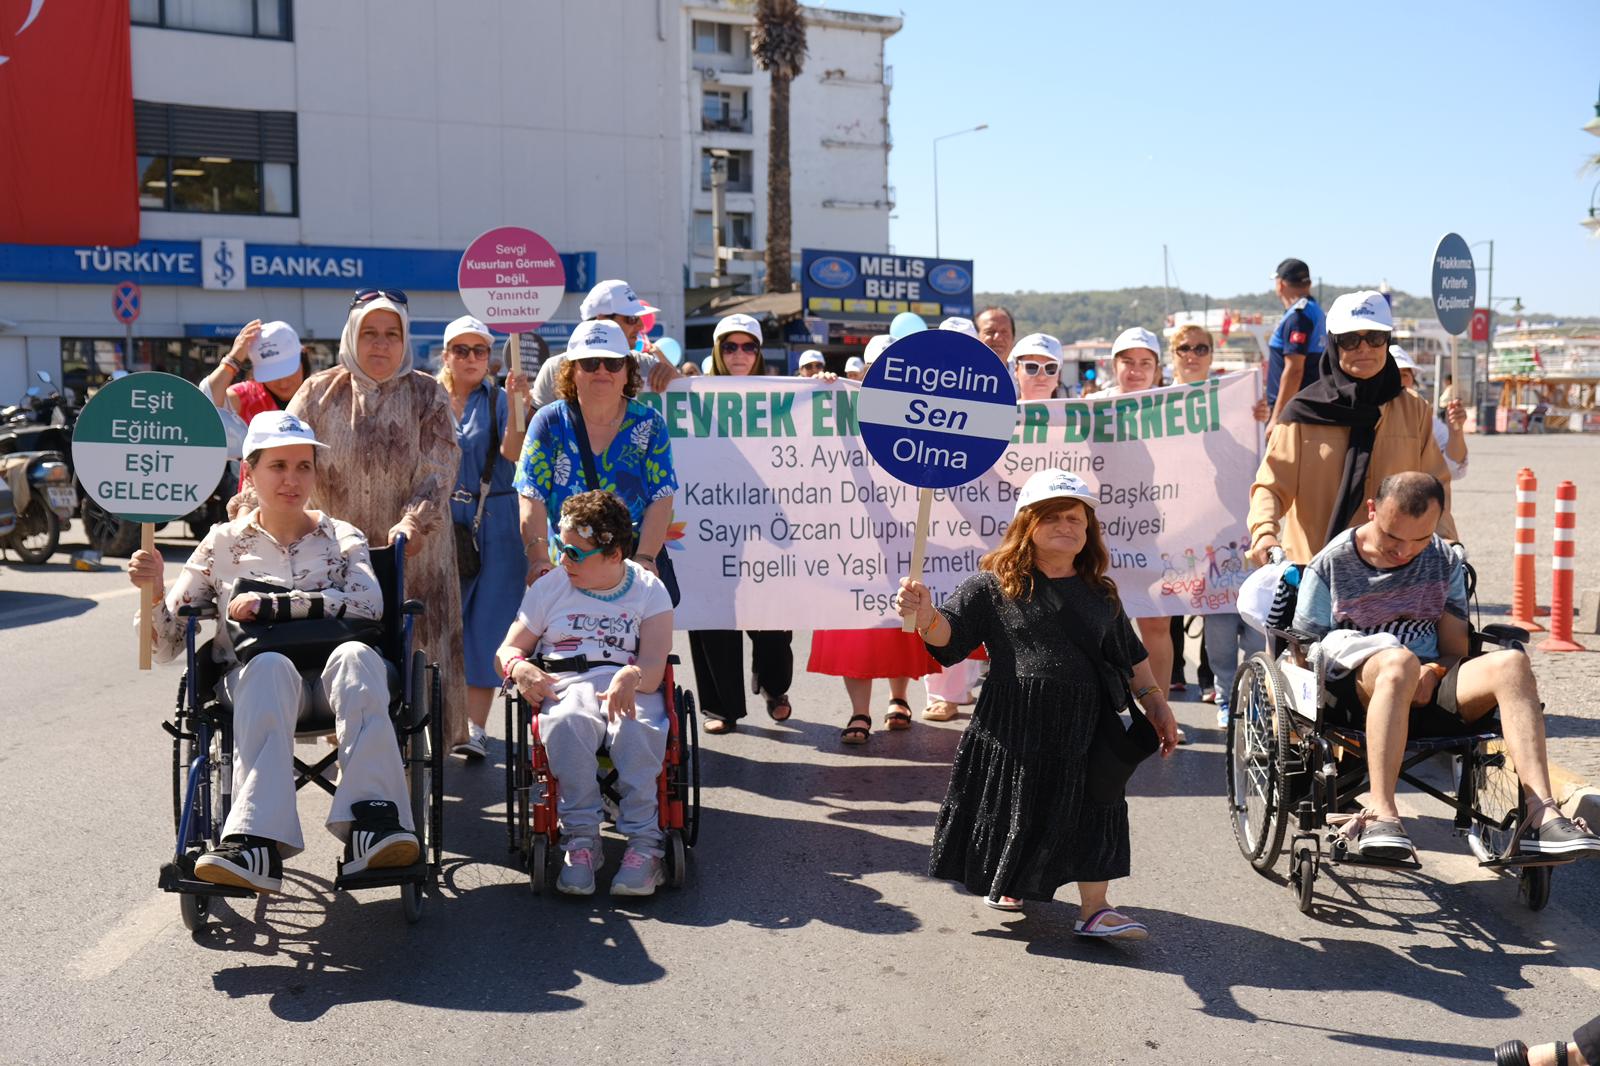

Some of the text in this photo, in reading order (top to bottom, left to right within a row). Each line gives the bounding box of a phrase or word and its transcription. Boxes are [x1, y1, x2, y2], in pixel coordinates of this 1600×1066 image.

[74, 245, 195, 274] TÜRKİYE
[250, 255, 363, 278] BANKASI
[496, 244, 526, 256] Sevgi
[466, 258, 556, 269] Kusurları Görmek
[495, 273, 529, 285] Değil,
[1441, 276, 1468, 289] Kriterle
[487, 290, 538, 301] Yanında
[486, 306, 540, 317] Olmaktır
[884, 356, 998, 394] Engelim
[131, 389, 174, 413] Eşit
[1064, 379, 1220, 444] DERNEĞİ
[904, 399, 968, 430] Sen
[112, 419, 189, 443] Eğitim,
[126, 450, 174, 476] EŞİT
[771, 445, 804, 468] 33.
[1004, 451, 1105, 474] Şenliğine
[892, 437, 968, 470] Olma
[98, 480, 198, 502] GELECEK
[685, 481, 832, 506] Katkılarından
[841, 480, 906, 508] Dolayı
[916, 480, 990, 502] evrek
[1100, 482, 1179, 509] Başkanı
[699, 518, 762, 548] Sayın
[771, 513, 841, 542] Özcan
[850, 516, 939, 544] Ulupınr
[947, 520, 972, 537] ve
[1099, 512, 1166, 542] ediyesi
[722, 549, 982, 583] Engelli ve Yaşlı Hzmetl
[1161, 572, 1206, 596] sevgi
[1190, 588, 1230, 610] engel
[572, 613, 634, 633] LUCKY
